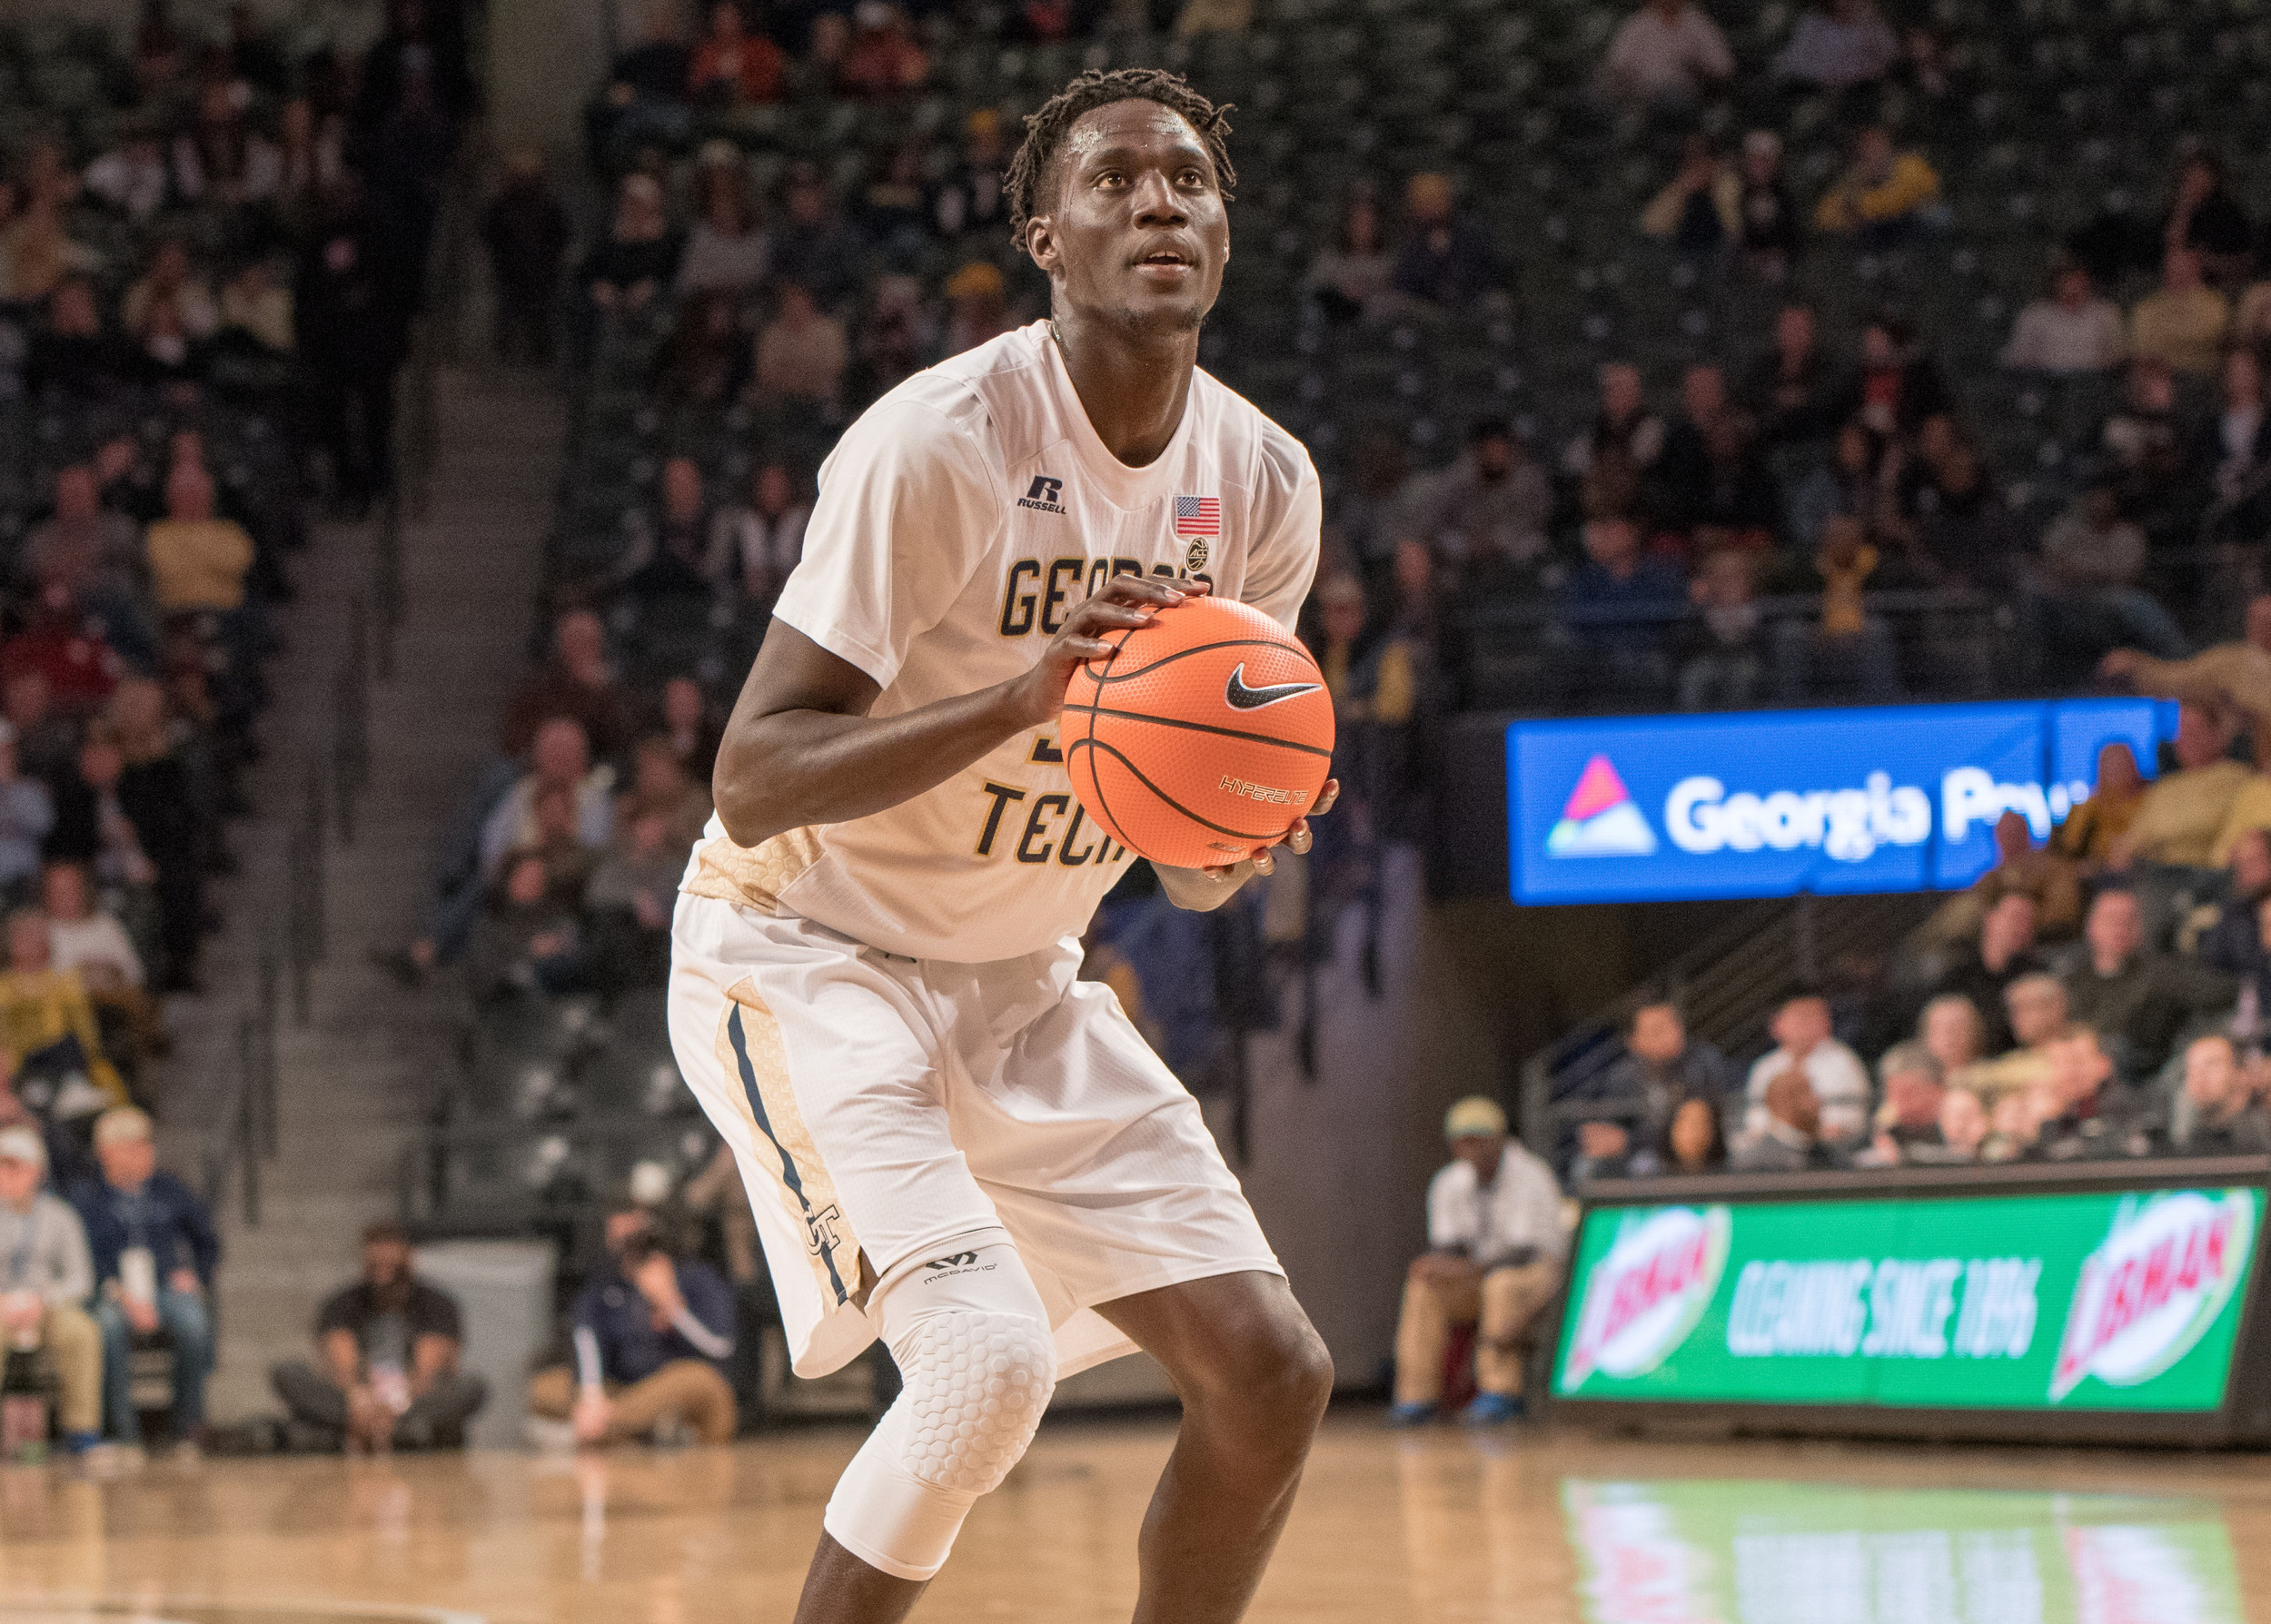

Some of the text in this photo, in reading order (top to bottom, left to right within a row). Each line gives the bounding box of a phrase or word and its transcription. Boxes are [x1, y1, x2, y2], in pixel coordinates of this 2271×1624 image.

[1016, 498, 1066, 515] RUSSELL
[1189, 548, 1208, 557] ACC
[1218, 775, 1309, 806] HYPERELITE
[974, 777, 1126, 868] TEC
[1664, 772, 1932, 862] Georgia
